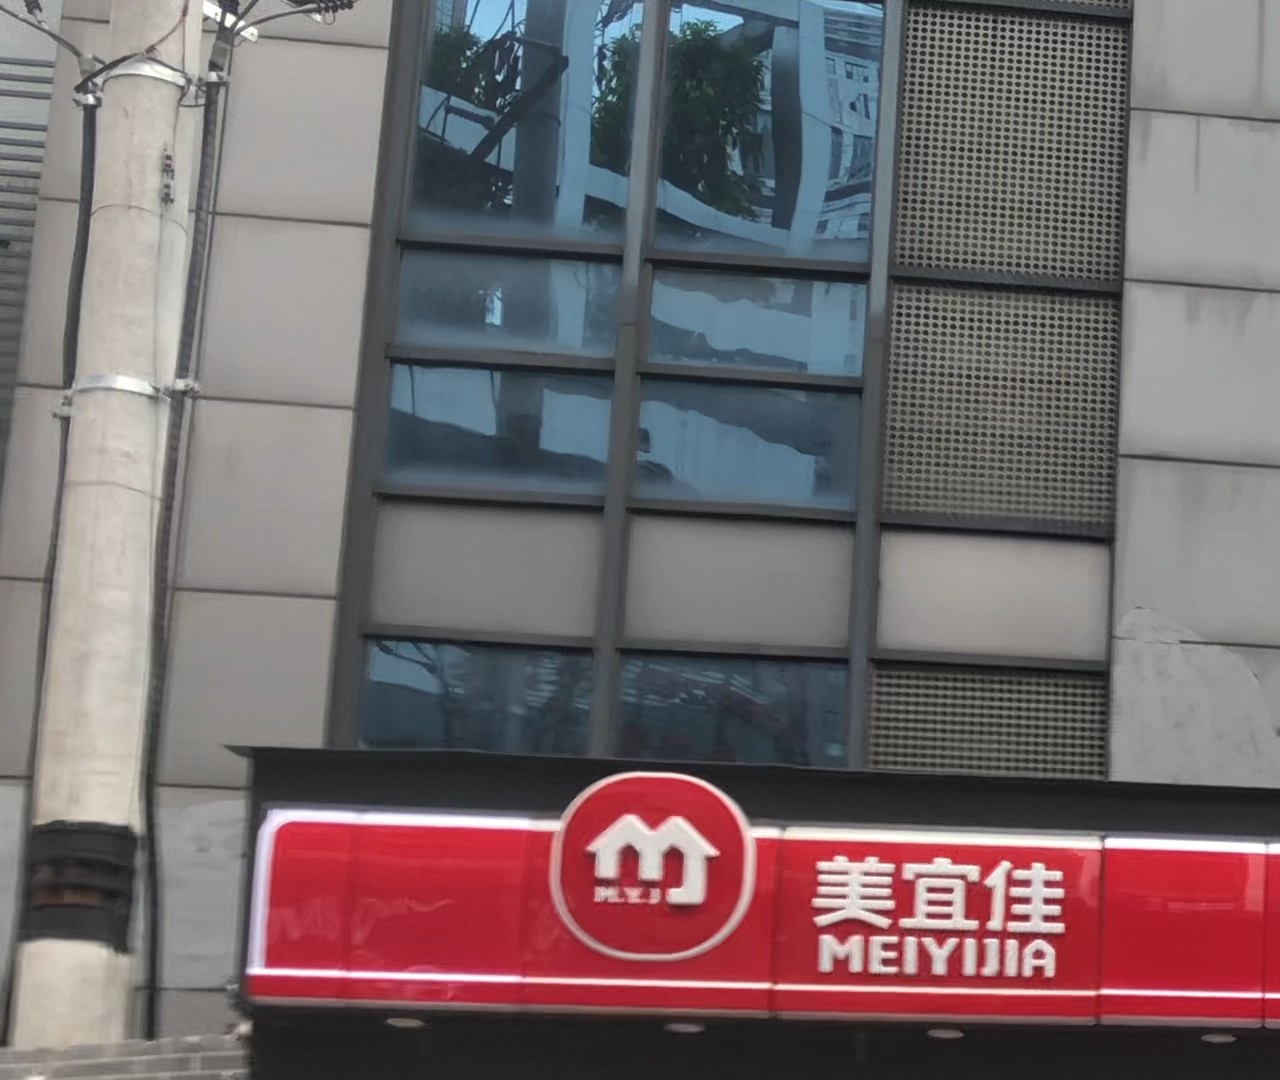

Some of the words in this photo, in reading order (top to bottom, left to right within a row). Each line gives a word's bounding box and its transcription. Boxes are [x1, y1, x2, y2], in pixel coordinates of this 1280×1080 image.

[811, 856, 1065, 934] 美宜佳
[817, 934, 1056, 978] MEIYIJIA
